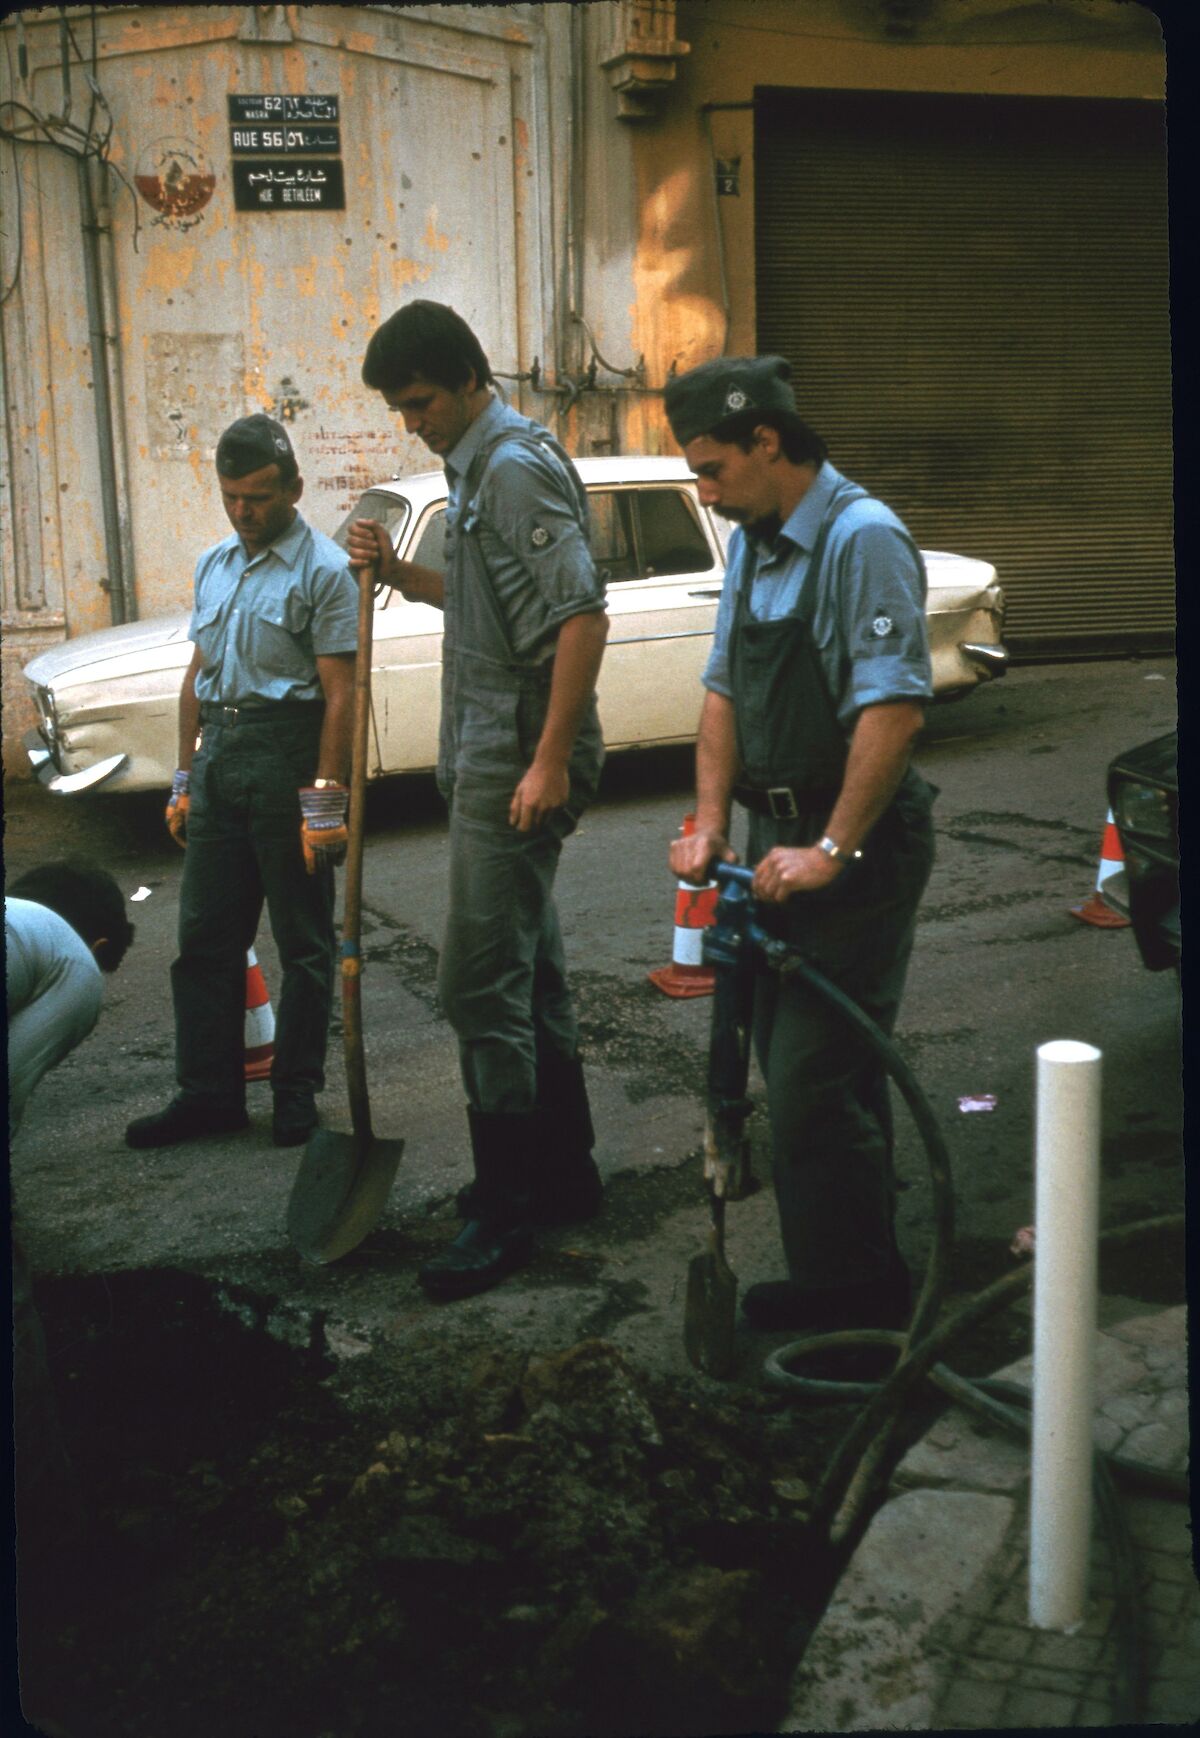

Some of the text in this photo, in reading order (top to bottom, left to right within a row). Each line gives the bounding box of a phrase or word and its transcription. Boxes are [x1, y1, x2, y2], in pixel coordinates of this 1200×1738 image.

[264, 97, 282, 110] 62
[285, 97, 300, 110] ٦٢
[245, 110, 269, 119] NASRA
[233, 132, 283, 147] RUE 56
[287, 132, 304, 147] ٥٦
[248, 168, 327, 187] شارع بيت لحم
[724, 179, 733, 192] 2
[259, 188, 273, 202] RUE
